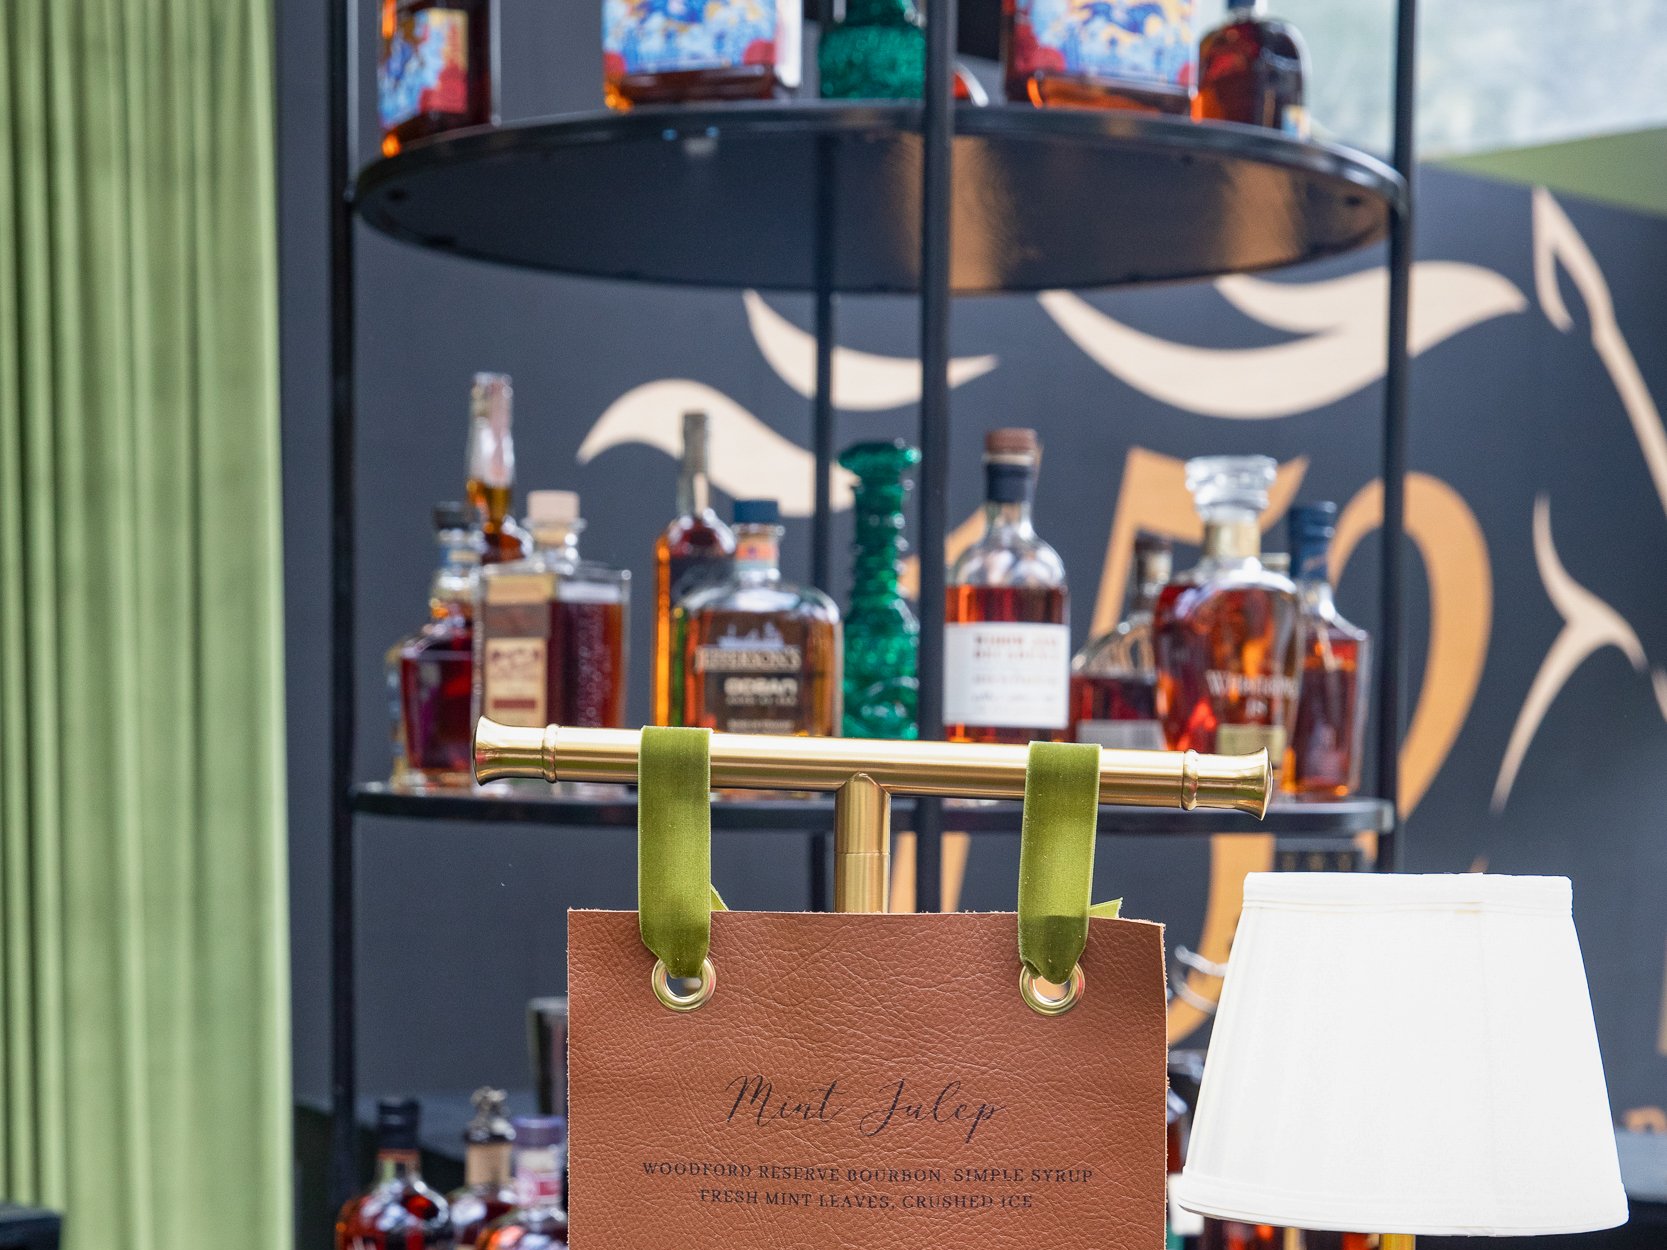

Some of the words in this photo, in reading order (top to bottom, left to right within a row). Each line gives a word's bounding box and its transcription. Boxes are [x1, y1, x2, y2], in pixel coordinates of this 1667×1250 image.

[725, 1074, 843, 1128] Mint
[859, 1078, 1005, 1144] Julep
[642, 1161, 752, 1179] WOODFORD
[759, 1164, 839, 1181] RESERVE
[847, 1168, 948, 1184] BOURBON,
[953, 1168, 1024, 1183] SIMPLE
[1031, 1168, 1093, 1184] SYRUP
[699, 1188, 759, 1205] FRESH
[765, 1192, 812, 1206] MINT
[818, 1194, 896, 1210] LEAVES,
[902, 1194, 994, 1209] CRUSHED
[1000, 1194, 1033, 1209] ICE
